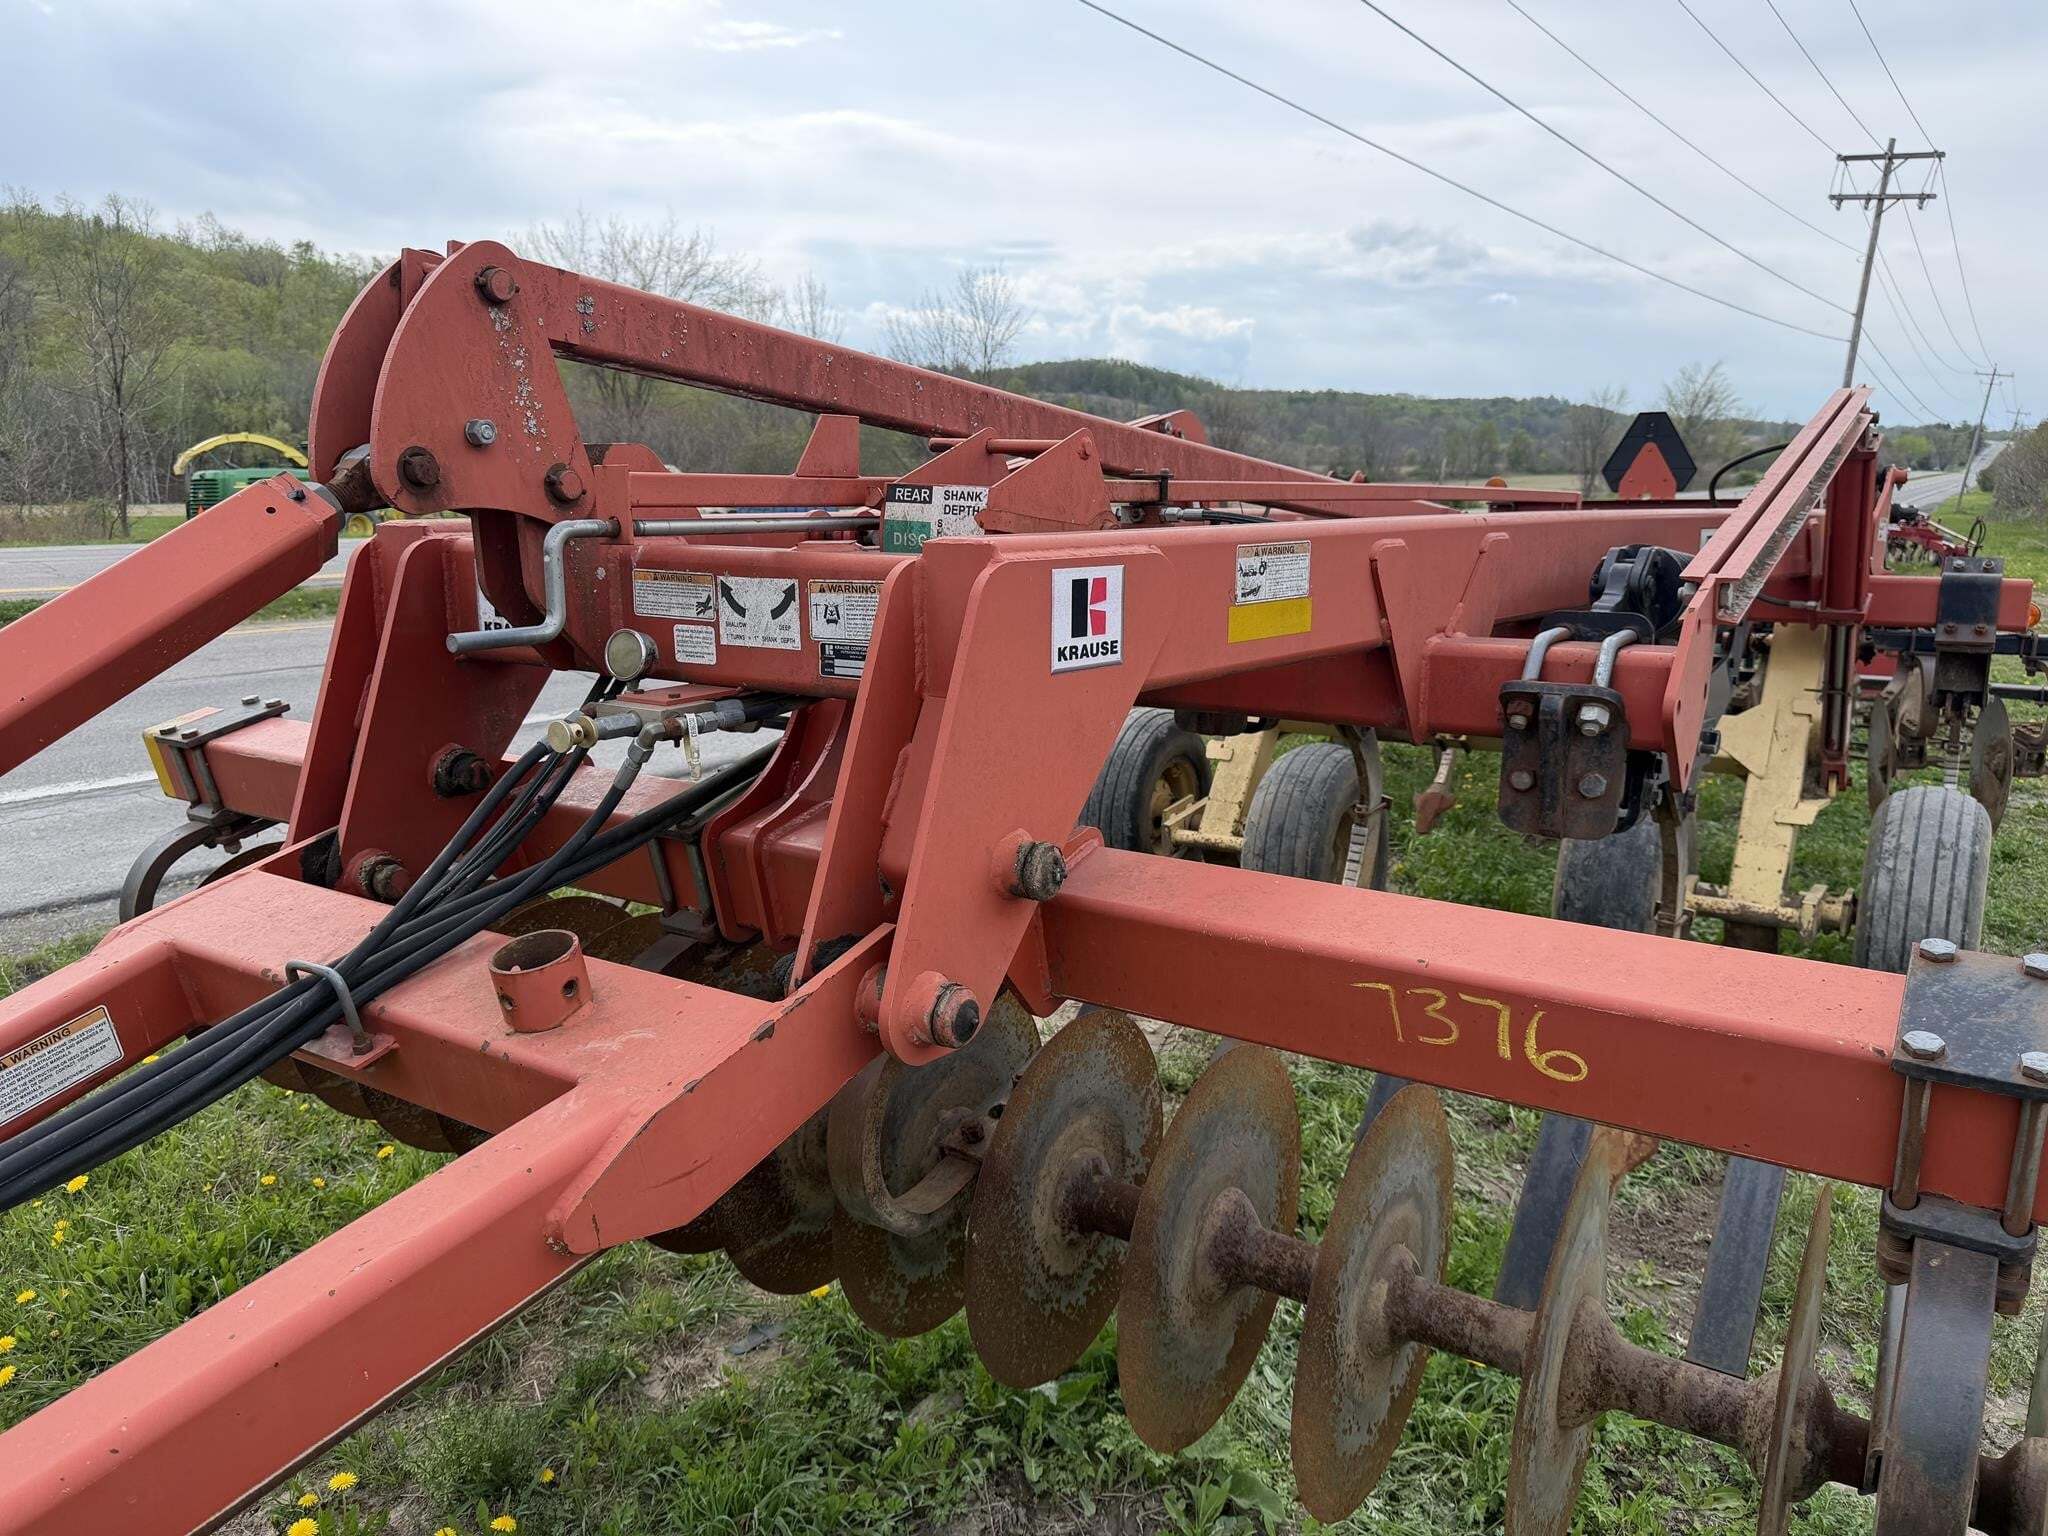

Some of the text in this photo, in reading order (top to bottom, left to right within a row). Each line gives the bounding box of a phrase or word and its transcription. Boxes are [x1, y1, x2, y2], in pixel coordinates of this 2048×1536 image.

[895, 488, 983, 502] REAR SHANK
[944, 504, 980, 516] DEPTH
[1261, 545, 1295, 556] WARNING
[660, 573, 692, 583] WARNING
[827, 584, 877, 594] WARNING
[1057, 640, 1119, 662] KRAUSE
[1350, 982, 1588, 1083] 7376
[9, 1026, 71, 1064] WARNING
